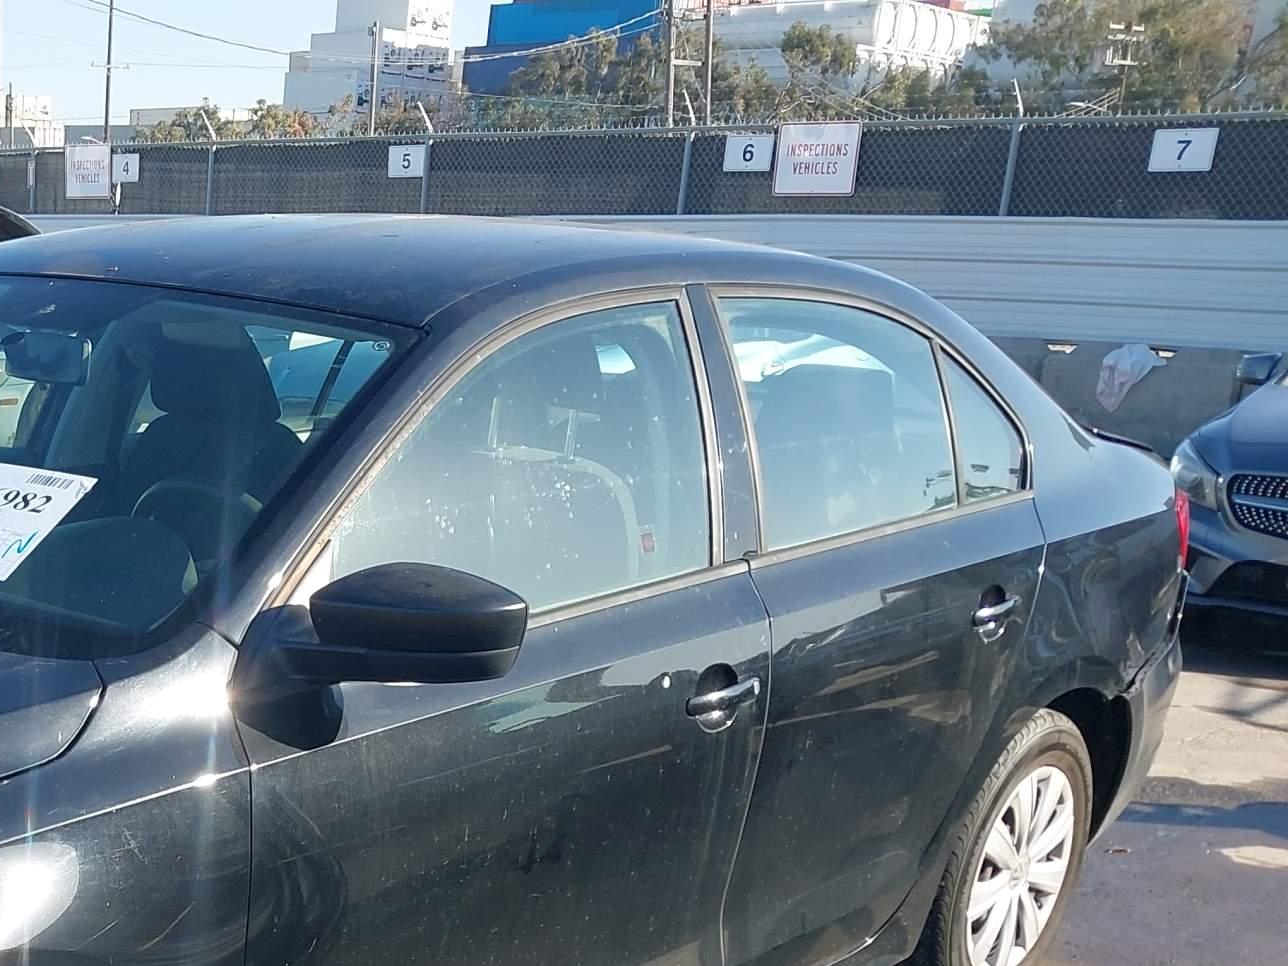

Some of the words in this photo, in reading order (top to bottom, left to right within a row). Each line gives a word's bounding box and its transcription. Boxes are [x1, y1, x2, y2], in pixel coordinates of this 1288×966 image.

[742, 143, 755, 163] 6
[786, 143, 849, 158] INSPECTIONS
[1176, 139, 1193, 161] 7
[70, 160, 105, 170] INSPECTIONS
[122, 161, 130, 175] 4
[402, 153, 411, 170] 5
[792, 161, 838, 176] VEHICLES
[74, 173, 100, 184] VEHICLES
